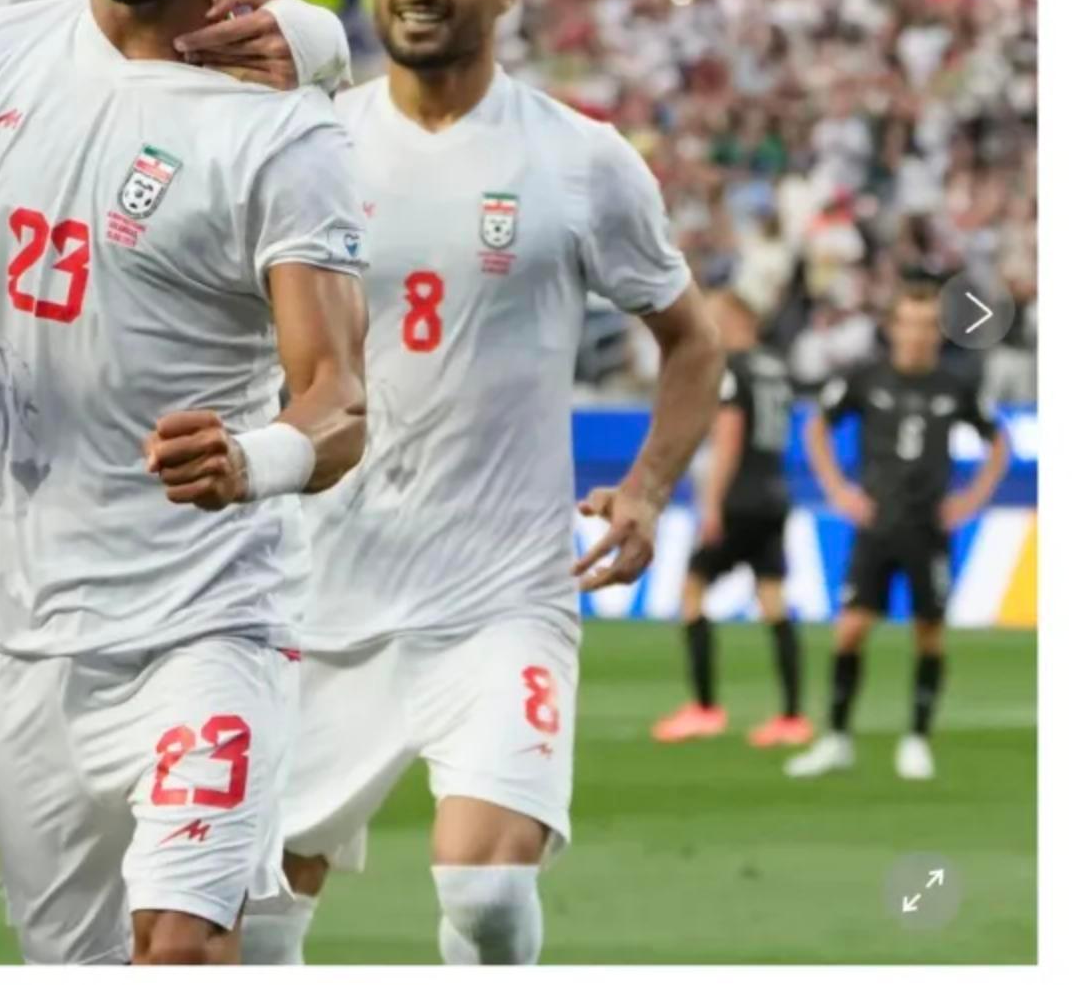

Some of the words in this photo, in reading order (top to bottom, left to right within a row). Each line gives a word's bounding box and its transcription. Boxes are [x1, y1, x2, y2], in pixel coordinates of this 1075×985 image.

[8, 208, 91, 323] 23
[403, 270, 444, 353] 8
[521, 665, 559, 734] 8
[151, 715, 250, 809] 23
